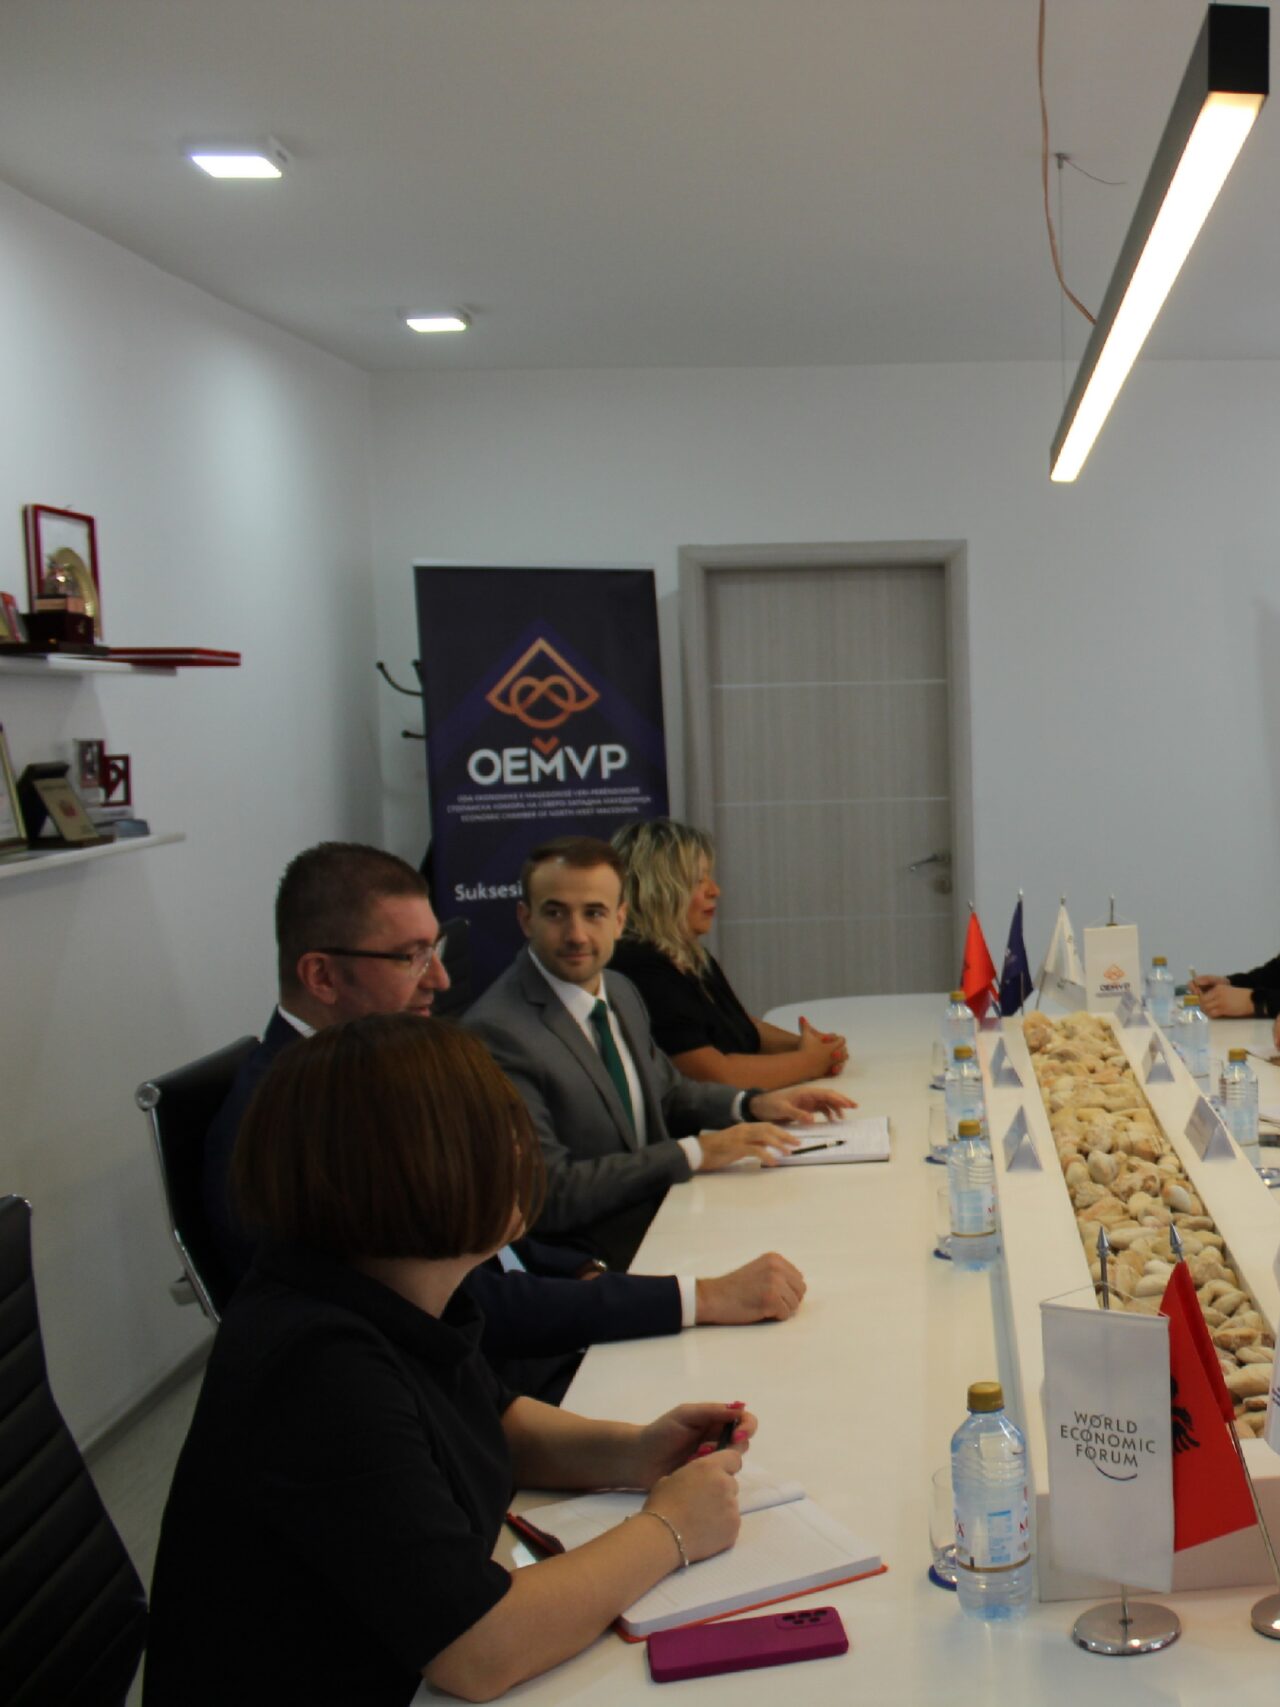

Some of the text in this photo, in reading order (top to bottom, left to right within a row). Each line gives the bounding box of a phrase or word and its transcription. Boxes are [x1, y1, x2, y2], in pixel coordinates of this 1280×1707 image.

[467, 744, 628, 785] OEMVP
[454, 881, 523, 902] Suksesi
[1074, 1410, 1138, 1434] WORLD
[1060, 1424, 1156, 1454] ECONOMIC
[1075, 1443, 1138, 1468] FORUM
